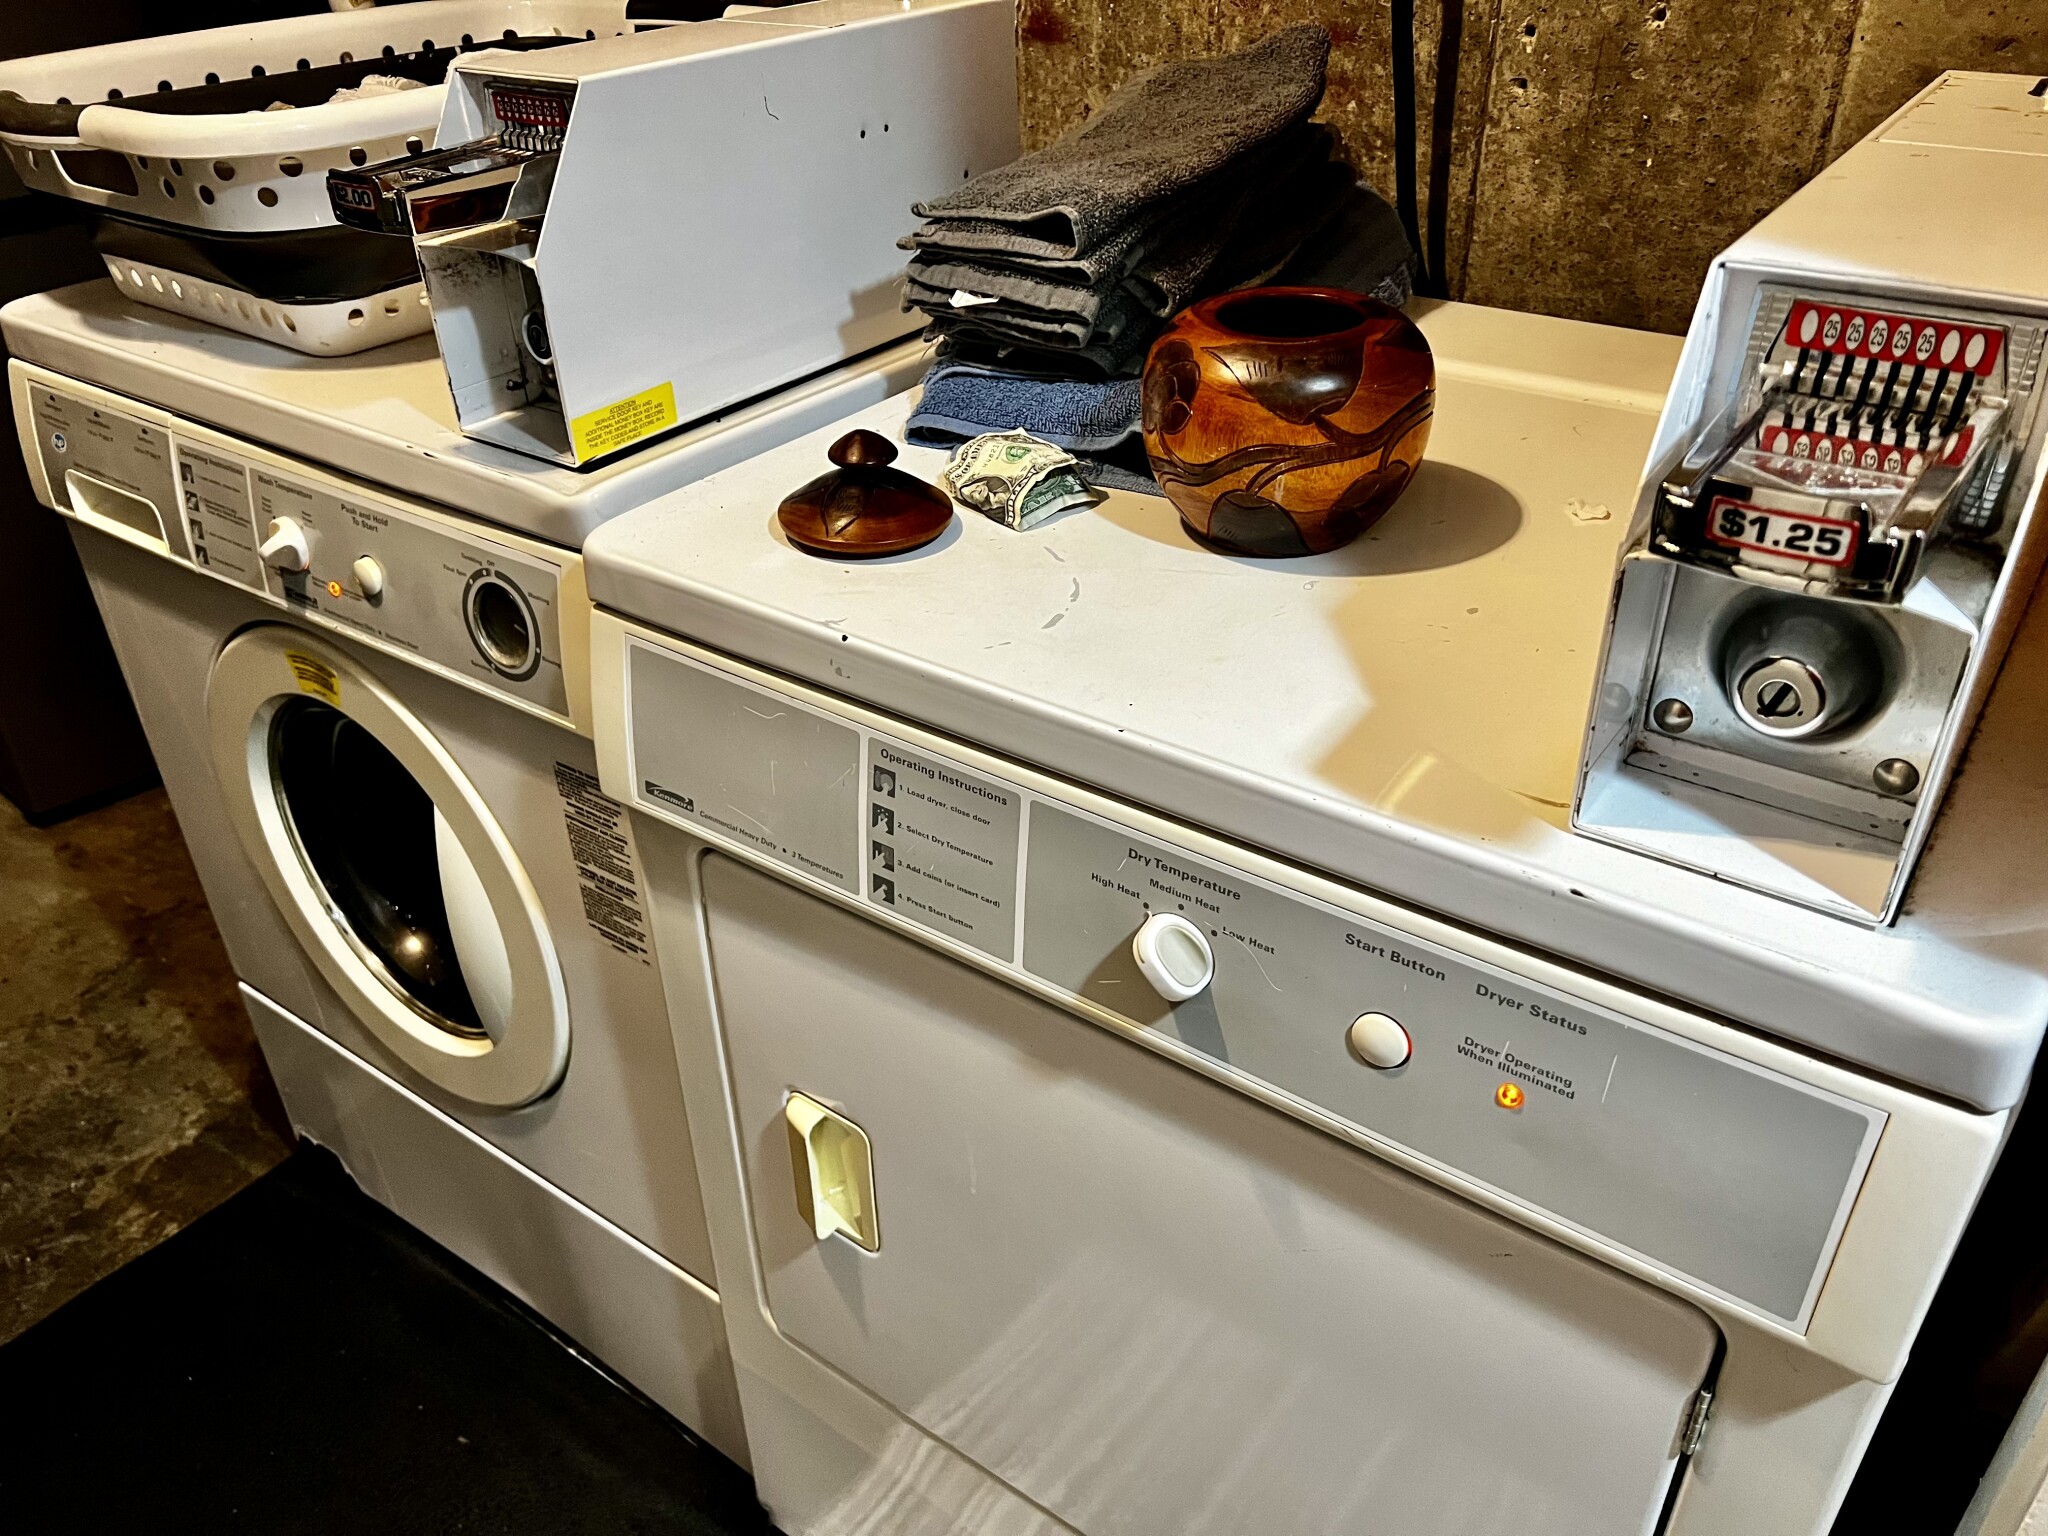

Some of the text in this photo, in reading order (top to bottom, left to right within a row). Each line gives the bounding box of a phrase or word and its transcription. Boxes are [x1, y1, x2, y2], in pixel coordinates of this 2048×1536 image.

[1824, 319, 1935, 354] 25 25 25 25 25
[586, 422, 614, 437] ADDITIONAL
[615, 414, 632, 425] MONEY
[654, 402, 664, 410] ARE
[595, 414, 615, 426] SERVICE
[617, 408, 632, 417] DOOR
[632, 404, 641, 412] KEY
[610, 400, 636, 414] ATTENTION
[587, 433, 602, 443] INSIDE
[614, 422, 632, 432] MONEY
[645, 408, 665, 419] RECORD
[611, 431, 627, 440] CODES
[640, 419, 655, 429] STORE
[341, 503, 389, 527] Push and Hold
[351, 516, 379, 533] To Start
[1719, 508, 1843, 556] $1.25
[880, 748, 1008, 806] Operating Instructions
[653, 788, 693, 811] Kenmore
[906, 787, 925, 800] Load
[926, 796, 949, 811] dryer,
[950, 806, 970, 818] close
[972, 814, 991, 826] door
[699, 810, 738, 832] Commercial
[739, 827, 760, 843] Heavy
[761, 837, 777, 851] Duty
[797, 853, 844, 879] Temperatures
[906, 825, 930, 840] Select
[931, 835, 945, 847] Dry
[946, 841, 994, 866] Temperature
[906, 863, 921, 874] Add
[922, 871, 943, 884] coins
[944, 879, 955, 889] (or
[956, 884, 979, 899] insert
[980, 896, 1001, 908] card)
[1091, 872, 1141, 900] High Heat
[1128, 848, 1241, 900] Dry Temperature
[906, 896, 926, 910] Press
[928, 905, 947, 919] Start
[948, 914, 974, 930] button
[1149, 878, 1221, 914] Medium Heat
[1222, 926, 1276, 955] Low Heat
[1344, 933, 1446, 981] Start Button
[1475, 983, 1587, 1036] Dryer Status
[1457, 1044, 1576, 1100] When Illuminated
[1464, 1036, 1573, 1089] Dryer Operating
